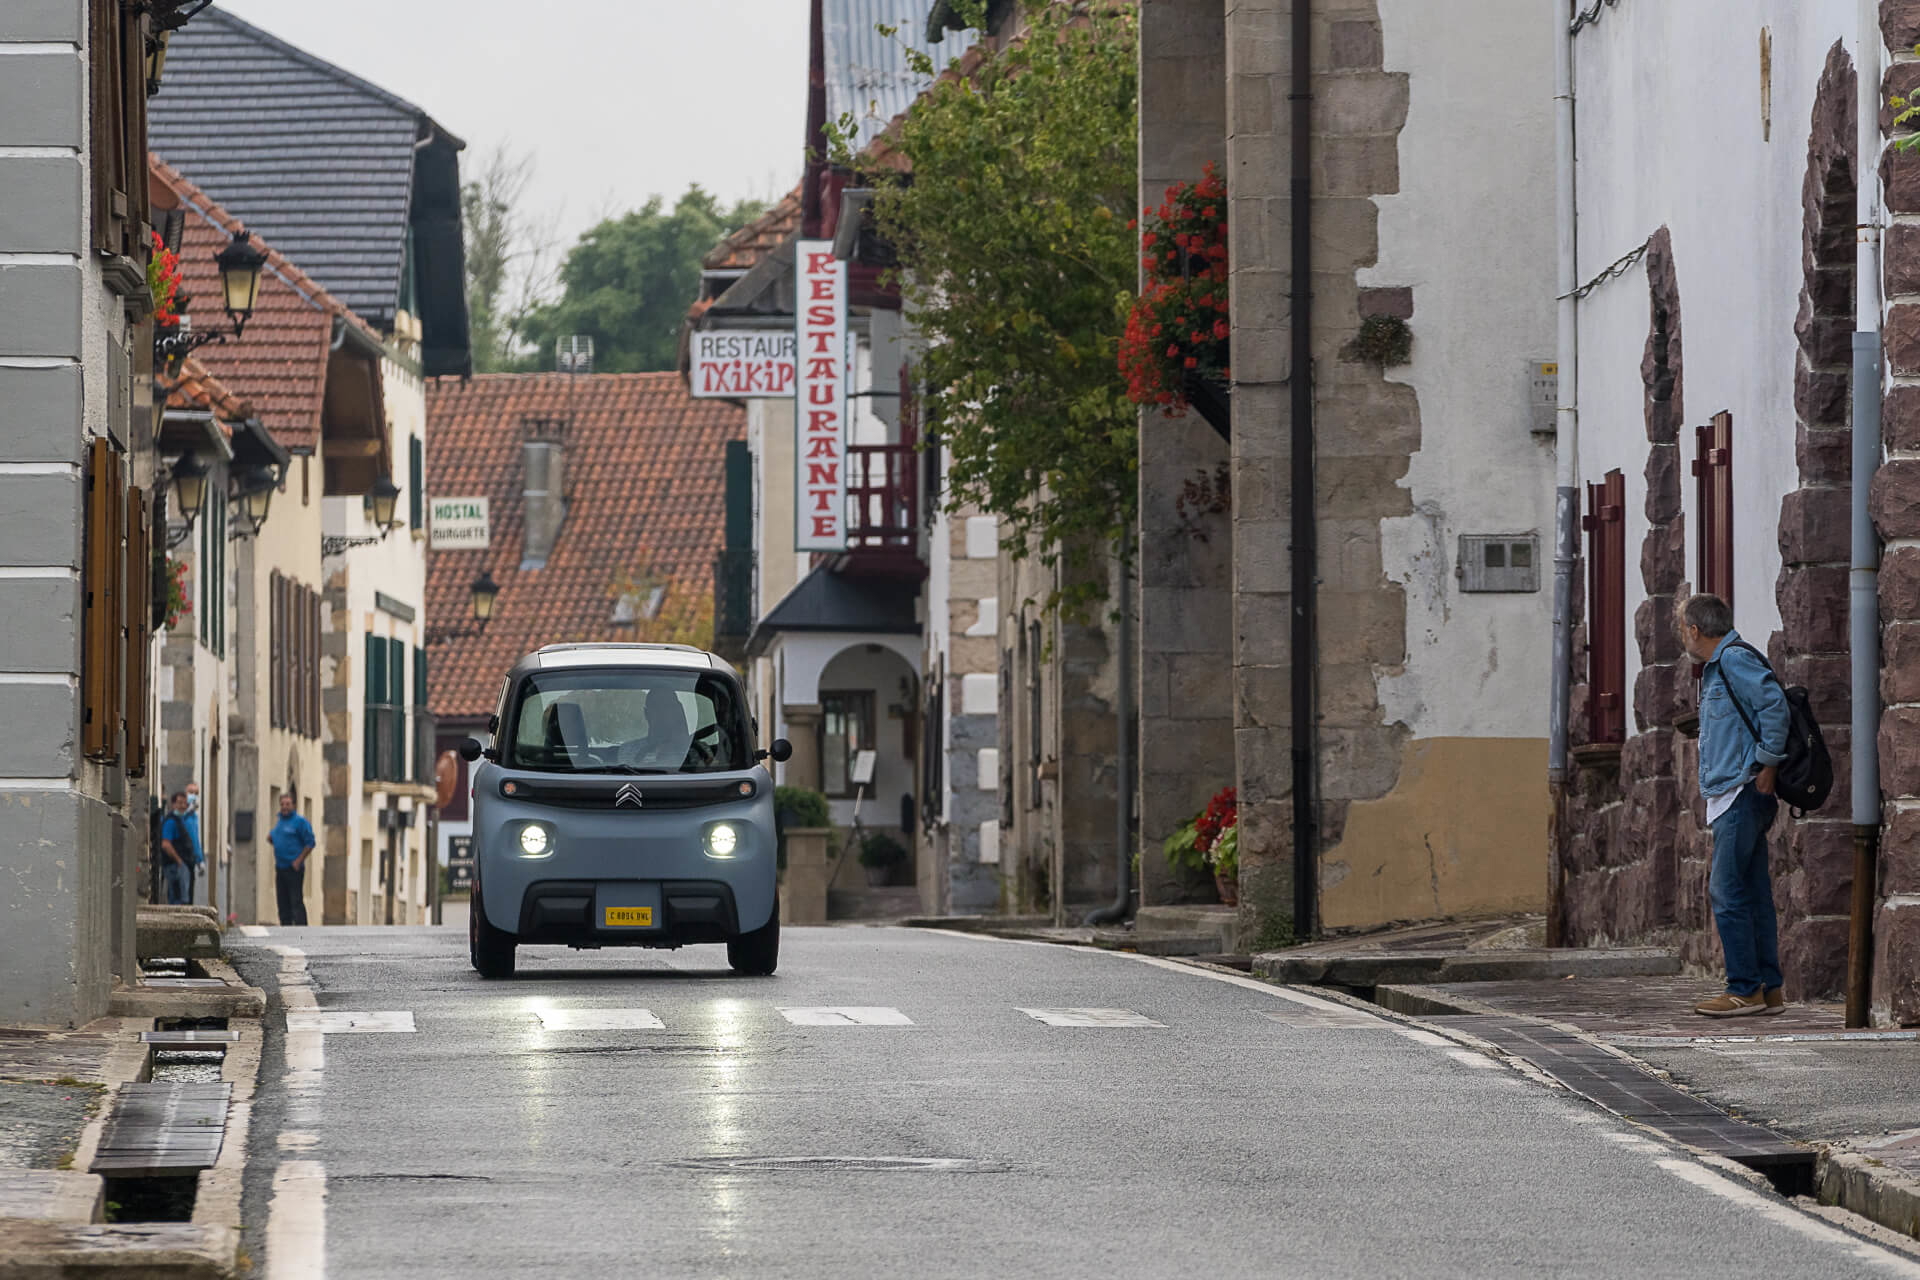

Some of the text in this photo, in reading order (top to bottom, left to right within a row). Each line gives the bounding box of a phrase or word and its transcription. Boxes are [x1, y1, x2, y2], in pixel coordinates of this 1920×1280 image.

[701, 337, 797, 358] RESTAUR
[805, 252, 838, 537] RESTAURANTE
[435, 503, 483, 520] HOSTAL
[433, 527, 485, 540] BURGUETE
